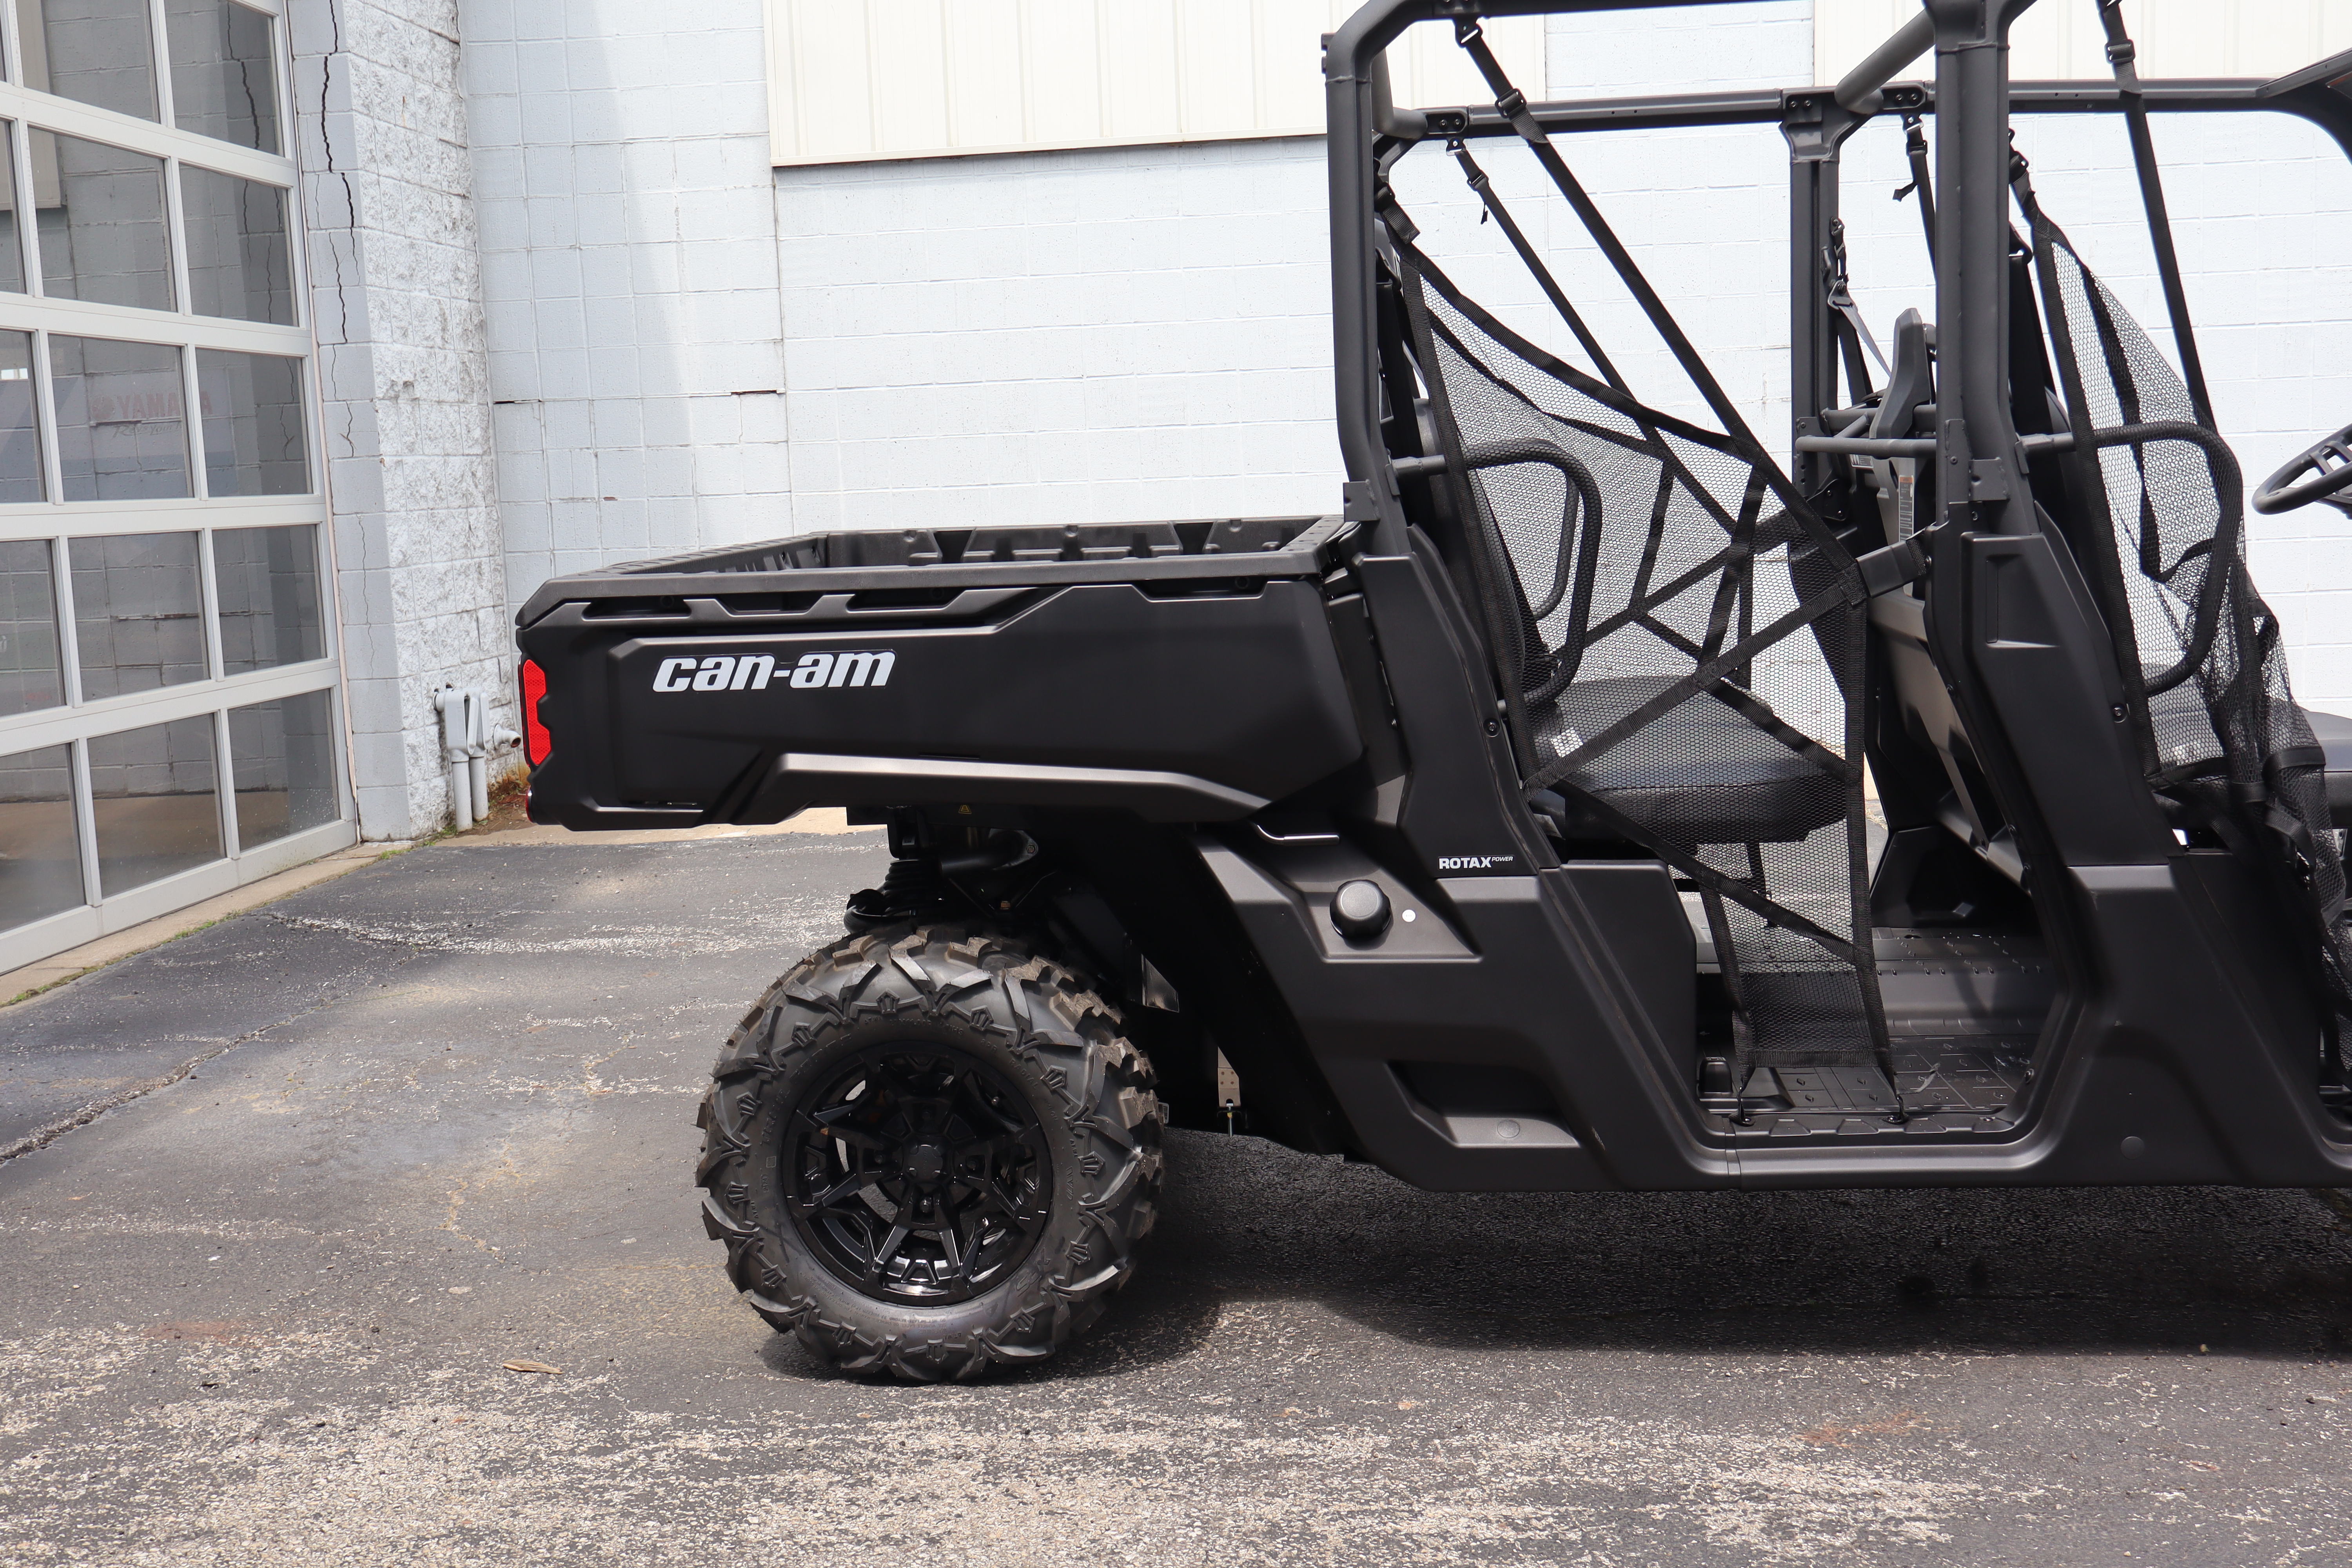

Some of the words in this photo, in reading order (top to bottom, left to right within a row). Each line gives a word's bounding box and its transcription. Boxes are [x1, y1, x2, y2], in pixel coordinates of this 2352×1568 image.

[117, 391, 213, 419] YAMAA
[653, 650, 896, 693] can-am
[1439, 857, 1492, 869] ROTAX
[1009, 1058, 1038, 1090] RADIAL
